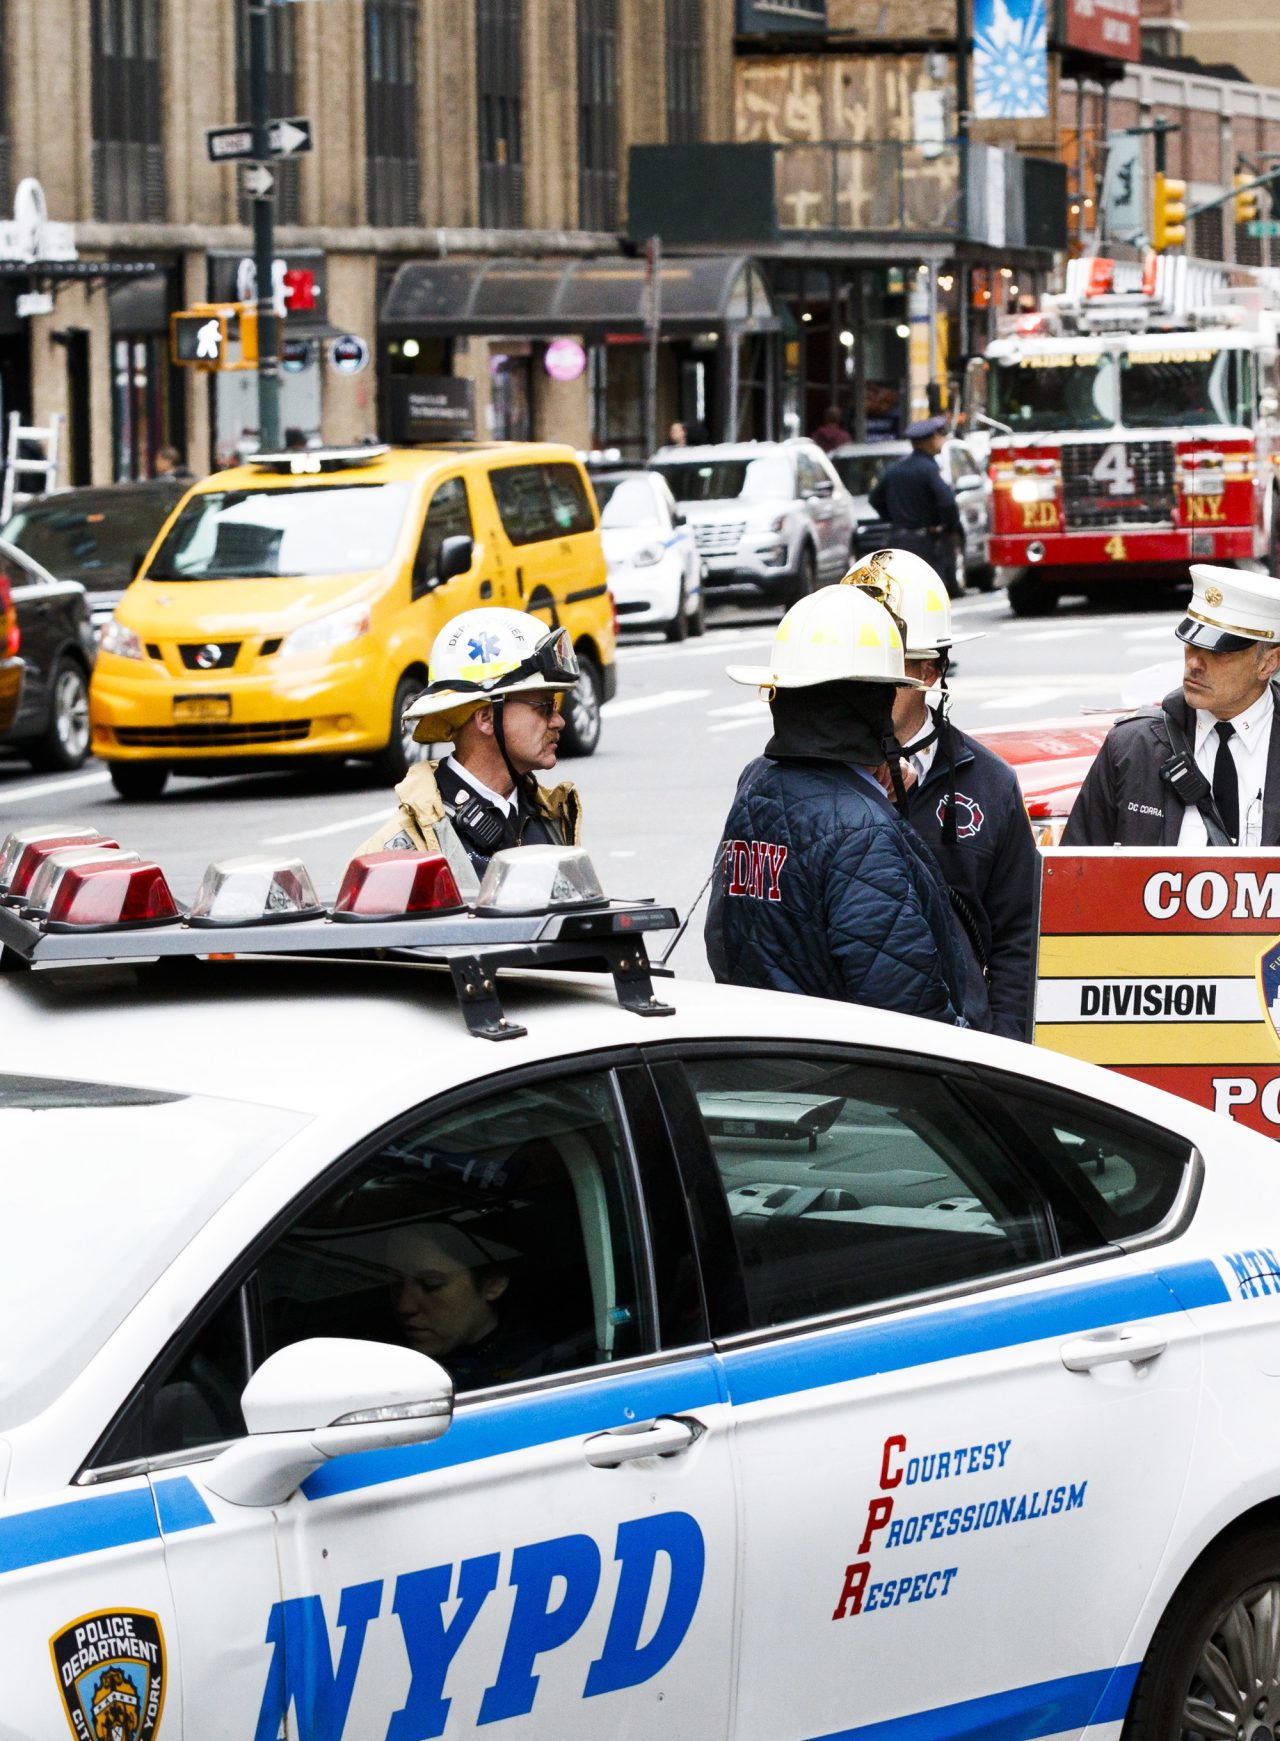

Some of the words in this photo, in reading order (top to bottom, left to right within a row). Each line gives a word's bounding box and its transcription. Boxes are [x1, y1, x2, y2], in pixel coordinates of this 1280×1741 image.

[1093, 444, 1136, 495] 4
[1104, 536, 1127, 560] 4
[1139, 803, 1165, 818] CORRA
[1080, 984, 1217, 1016] DIVISION
[879, 1434, 1012, 1490] COURTESY
[857, 1480, 1088, 1555] PROFESSIONALISM
[832, 1561, 958, 1621] RESPECT
[75, 1617, 135, 1649] POLICE
[255, 1511, 706, 1741] NYPD
[62, 1637, 158, 1687] DEPARTMENT
[72, 1708, 93, 1741] CIT
[144, 1676, 161, 1728] YORK
